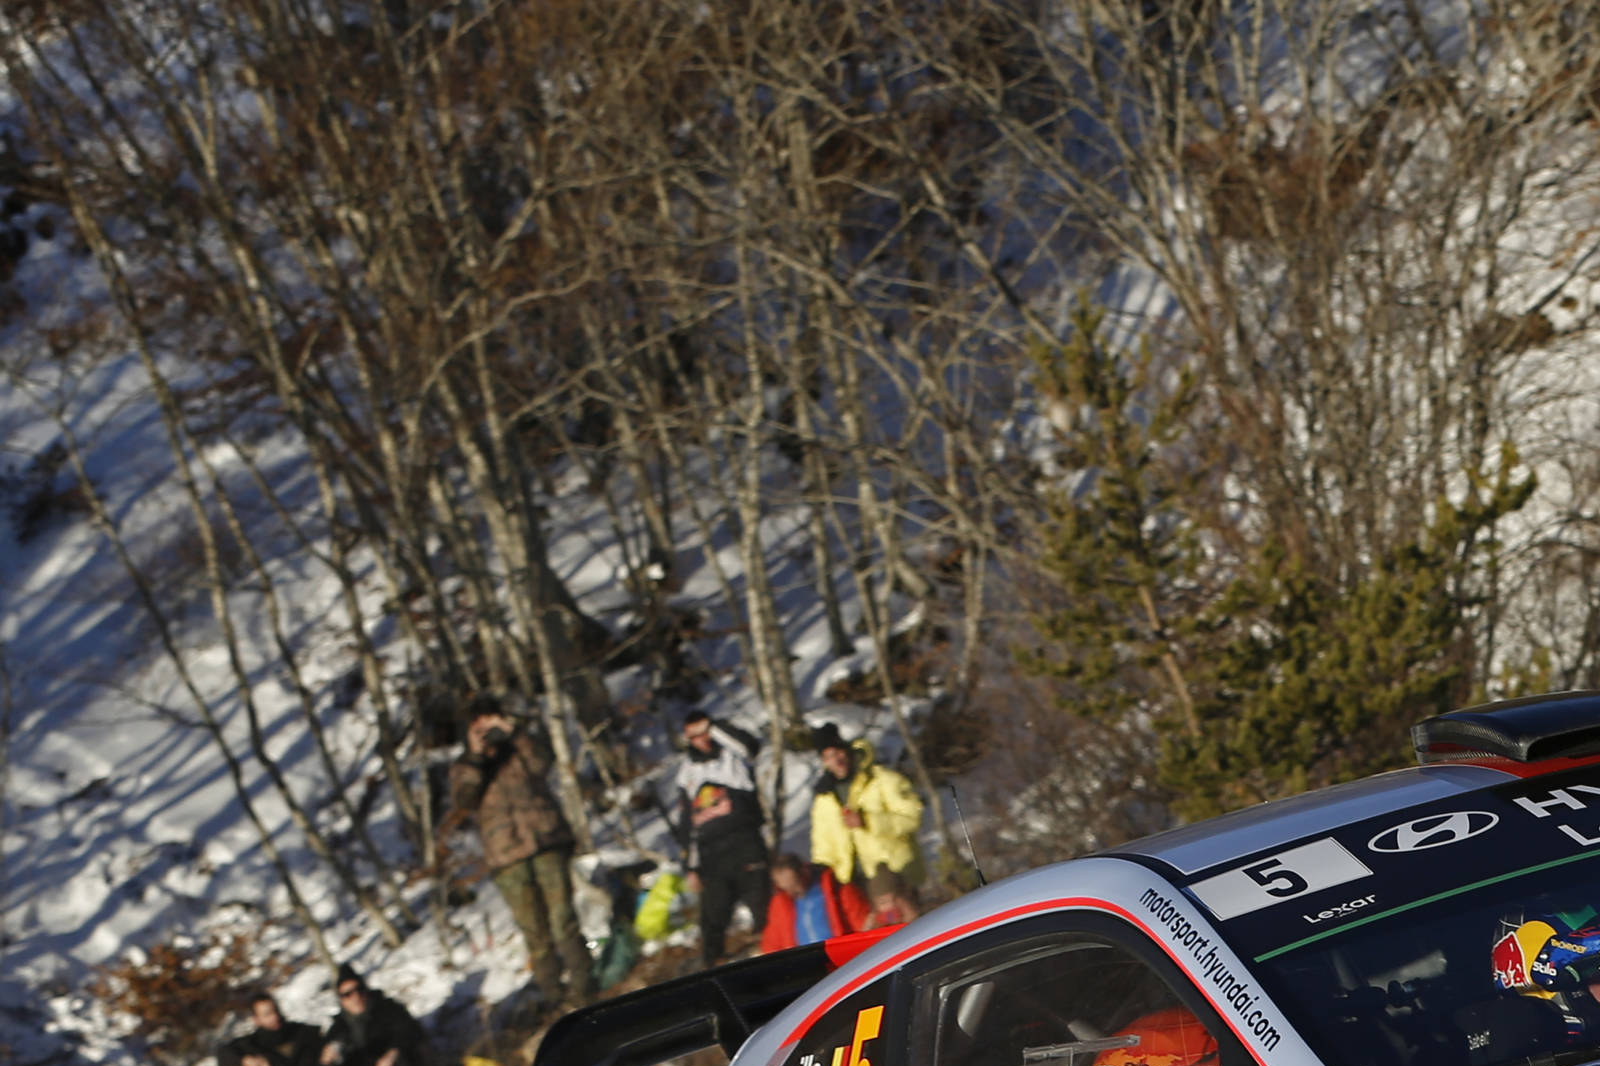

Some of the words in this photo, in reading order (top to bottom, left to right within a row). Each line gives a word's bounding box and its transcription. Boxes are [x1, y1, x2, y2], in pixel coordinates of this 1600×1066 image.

[1241, 858, 1309, 898] 5
[1303, 893, 1377, 924] Lexar
[1139, 887, 1282, 1052] motorsport.hyundai.com
